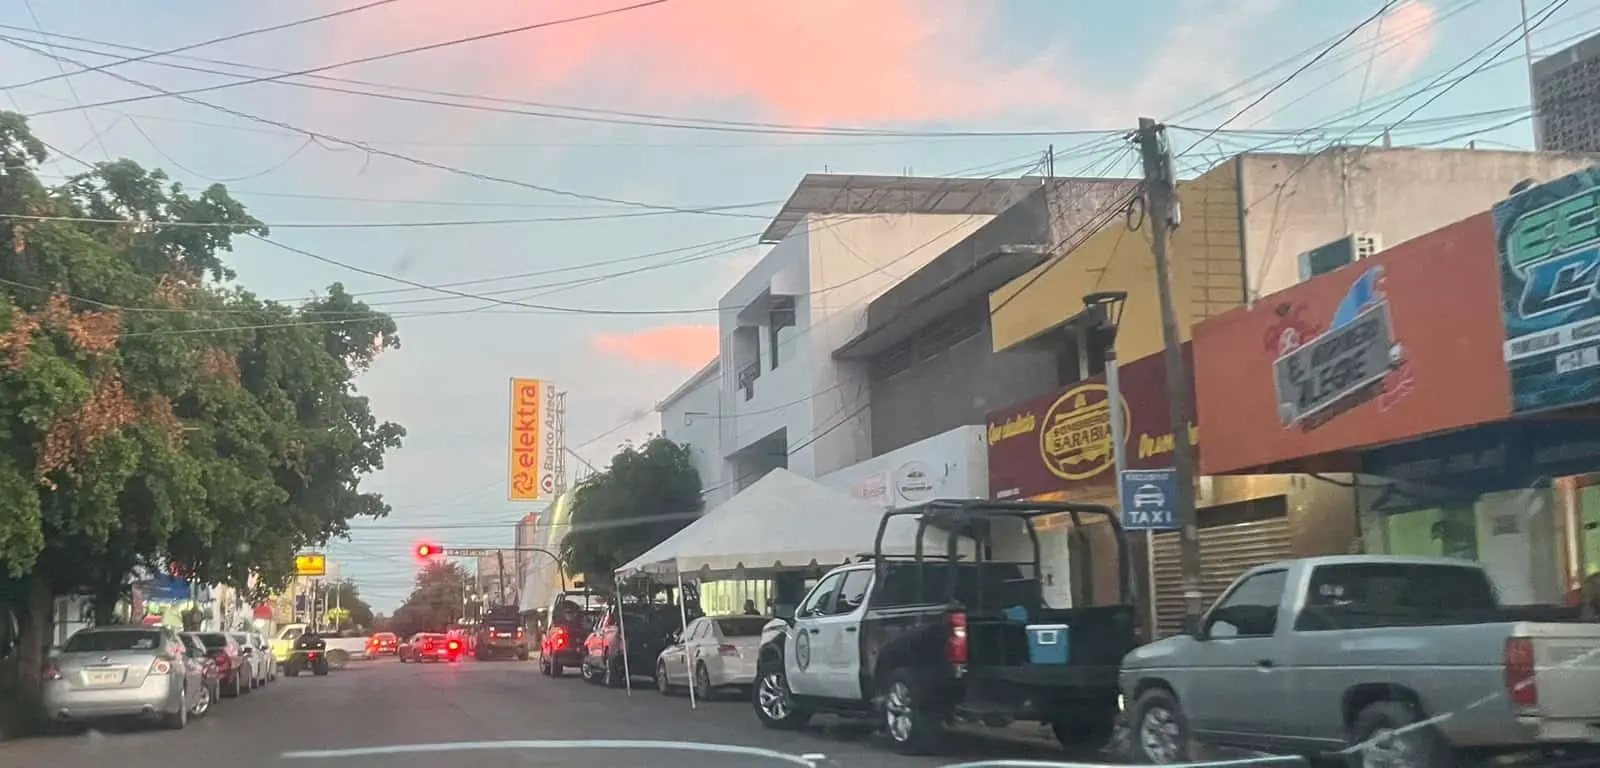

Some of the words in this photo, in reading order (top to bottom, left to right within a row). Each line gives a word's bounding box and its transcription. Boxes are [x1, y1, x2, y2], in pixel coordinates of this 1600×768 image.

[514, 385, 536, 468] elektra
[544, 432, 554, 471] Banco
[1128, 511, 1172, 524] TAXI
